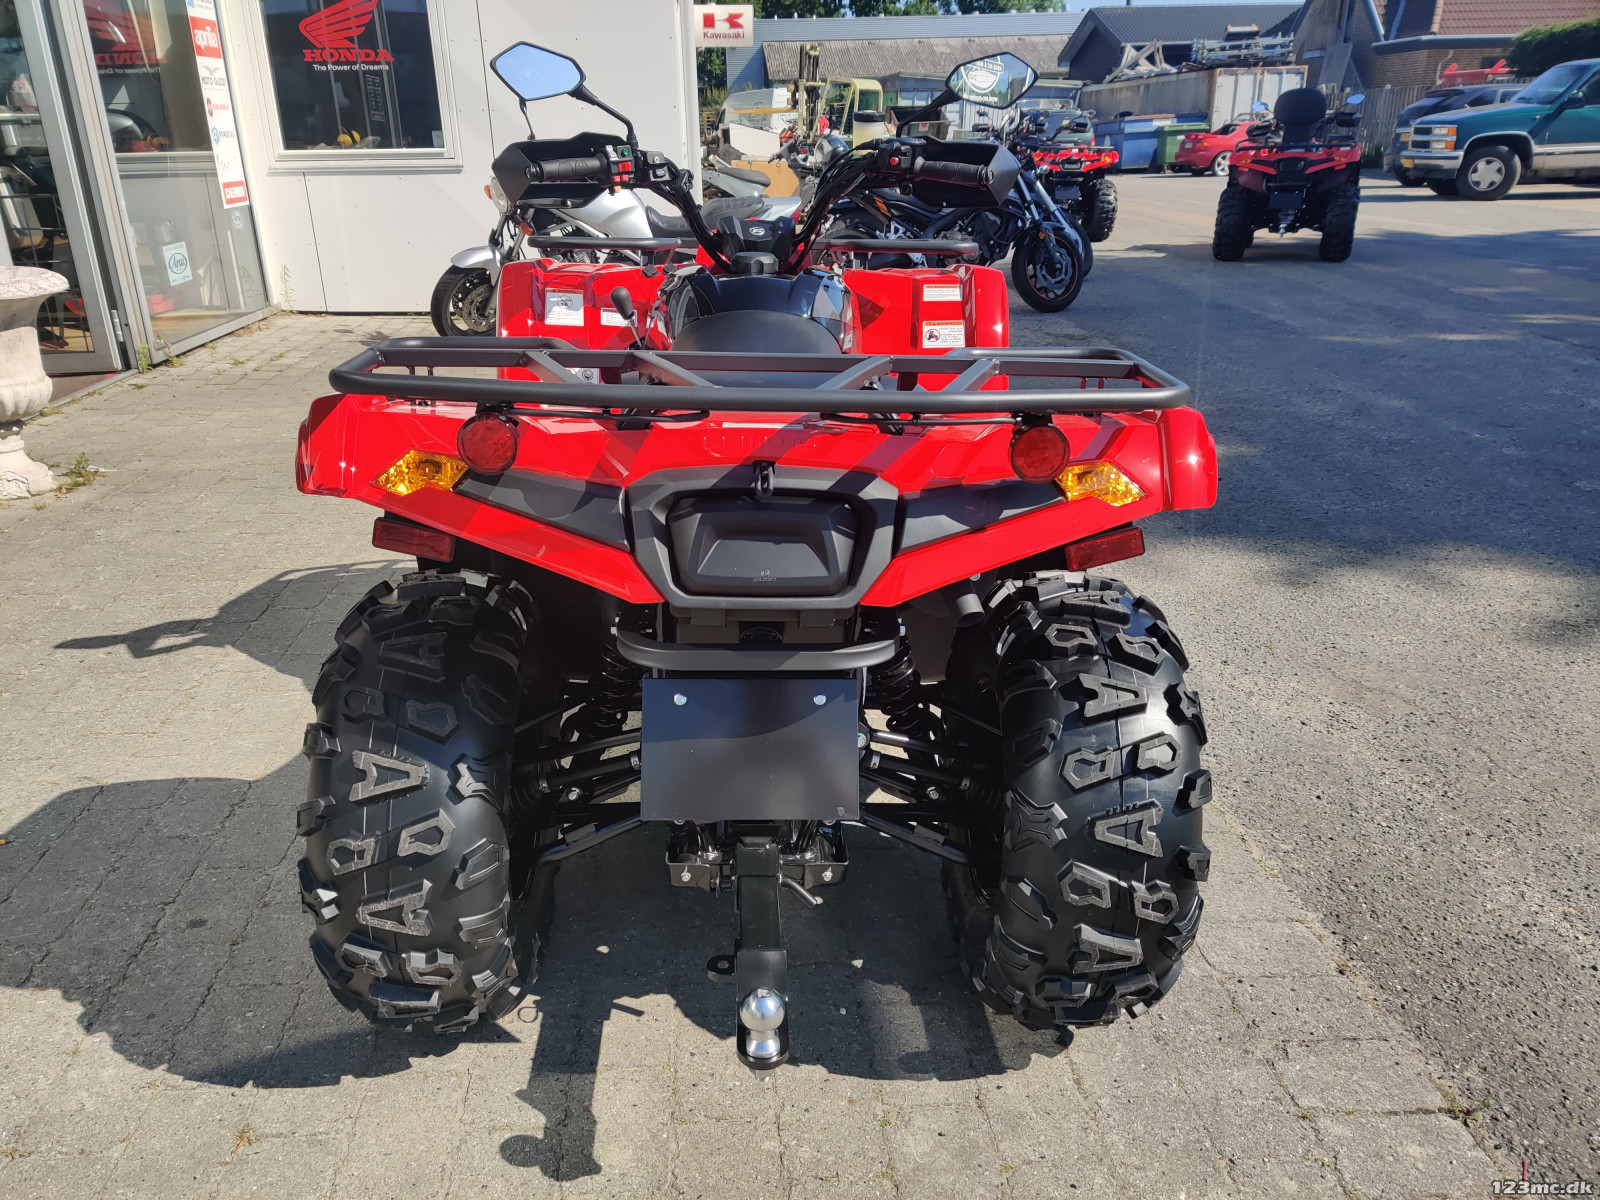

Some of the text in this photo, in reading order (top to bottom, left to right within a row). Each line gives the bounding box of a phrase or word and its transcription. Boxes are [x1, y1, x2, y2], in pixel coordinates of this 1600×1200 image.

[194, 25, 218, 49] aprilia
[703, 31, 745, 39] Kawasaki
[303, 49, 394, 62] HONDA
[327, 63, 350, 71] Power
[352, 63, 360, 71] of
[361, 63, 389, 71] Dreams
[225, 186, 245, 199] DERBI
